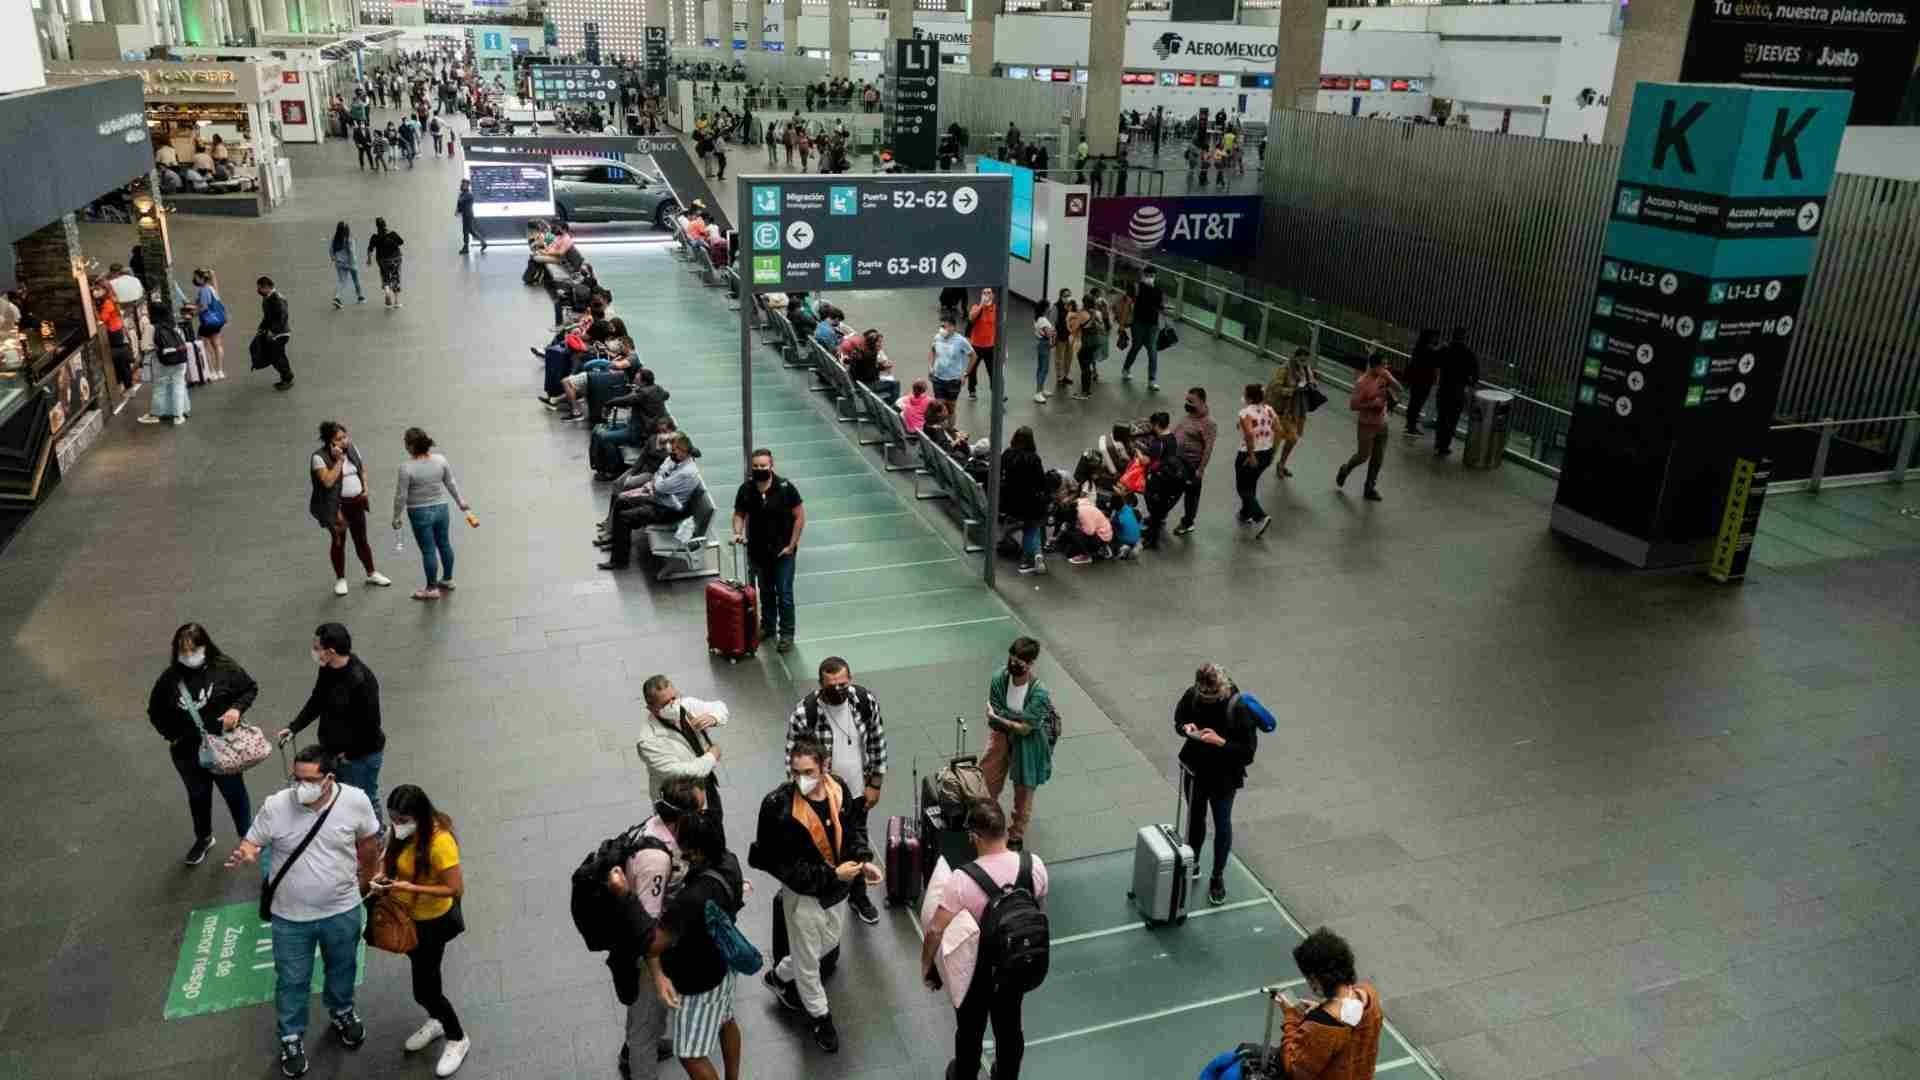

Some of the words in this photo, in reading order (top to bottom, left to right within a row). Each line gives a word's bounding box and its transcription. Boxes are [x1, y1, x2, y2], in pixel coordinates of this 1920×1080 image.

[1713, 0, 1732, 15] Tu
[1776, 5, 1828, 21] nuestra
[1831, 6, 1907, 25] plataforma.
[648, 28, 664, 41] L2
[906, 44, 931, 70] L1
[1756, 44, 1801, 63] JEEVES
[1652, 99, 1712, 175] K
[1762, 107, 1822, 181] K
[863, 193, 888, 202] Puerta
[893, 190, 947, 209] 52-62
[1729, 207, 1757, 218] Acceso
[1171, 212, 1243, 240] AT&T
[858, 260, 882, 269] Puerta
[887, 257, 936, 275] 63-81
[1620, 267, 1656, 287] L1-L3
[1727, 284, 1761, 299] L1-L3
[1661, 313, 1676, 331] M
[1762, 319, 1776, 335] M
[651, 874, 663, 897] 3
[198, 914, 219, 954] menor
[219, 925, 244, 958] Zona
[182, 955, 211, 1000] riesgo
[215, 958, 236, 978] de
